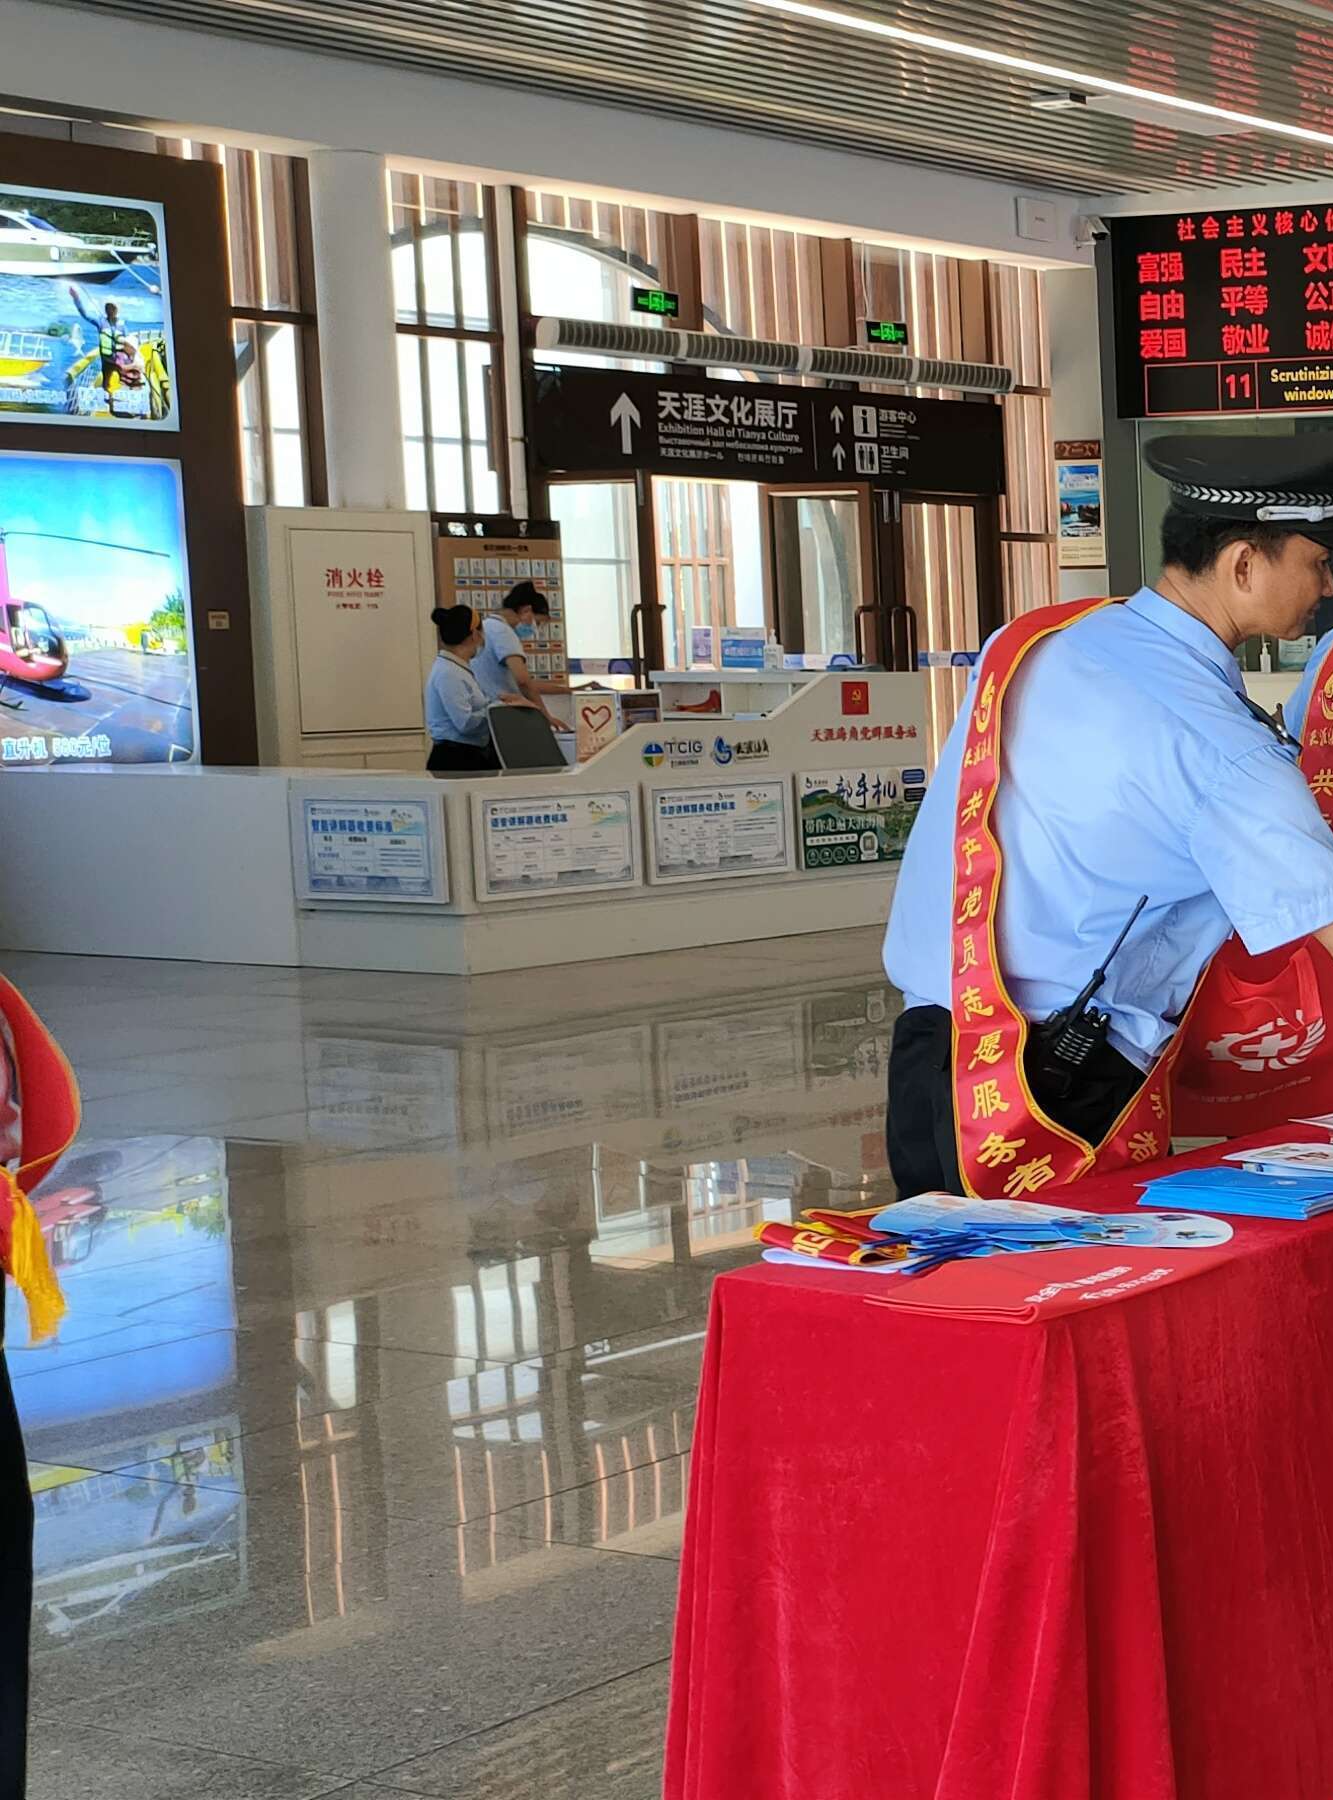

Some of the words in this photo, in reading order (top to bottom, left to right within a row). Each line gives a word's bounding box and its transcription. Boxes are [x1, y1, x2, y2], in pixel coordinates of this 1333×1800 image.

[1138, 252, 1185, 284] 富强
[1220, 247, 1268, 279] 民主
[1139, 290, 1185, 321] 自由
[1221, 286, 1268, 316] 平等
[1140, 328, 1186, 358] 爱国
[1222, 324, 1269, 355] 敬业
[1225, 373, 1251, 399] 11
[658, 391, 798, 430] 天涯文化展厅
[879, 408, 917, 424] 游客中心
[658, 423, 704, 437] Exhibition
[707, 427, 724, 437] Hall
[726, 428, 735, 438] of
[737, 429, 766, 442] Tianya
[768, 431, 800, 443] Culture
[881, 446, 909, 460] 卫生间
[326, 568, 385, 588] 消火栓
[811, 725, 917, 742] 天涯海角党群服务站
[664, 740, 702, 754] TCIG
[957, 791, 1055, 1196] 共产党员志愿服务者
